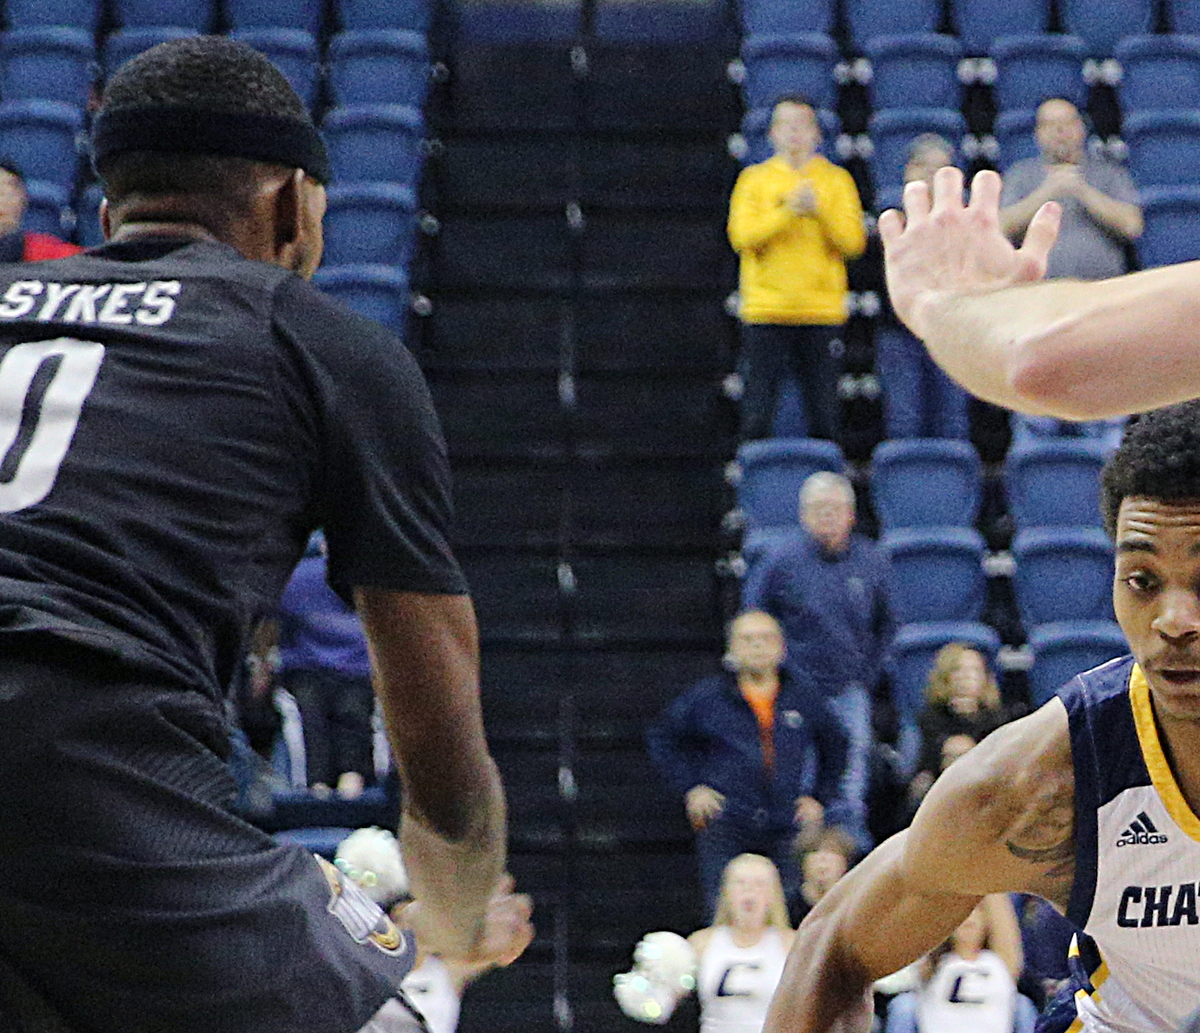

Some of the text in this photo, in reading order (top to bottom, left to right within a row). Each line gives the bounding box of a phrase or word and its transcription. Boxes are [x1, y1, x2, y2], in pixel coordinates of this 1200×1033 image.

[0, 280, 182, 326] SYKES
[1116, 832, 1168, 848] adidas
[717, 962, 761, 998] C
[948, 972, 990, 1004] C
